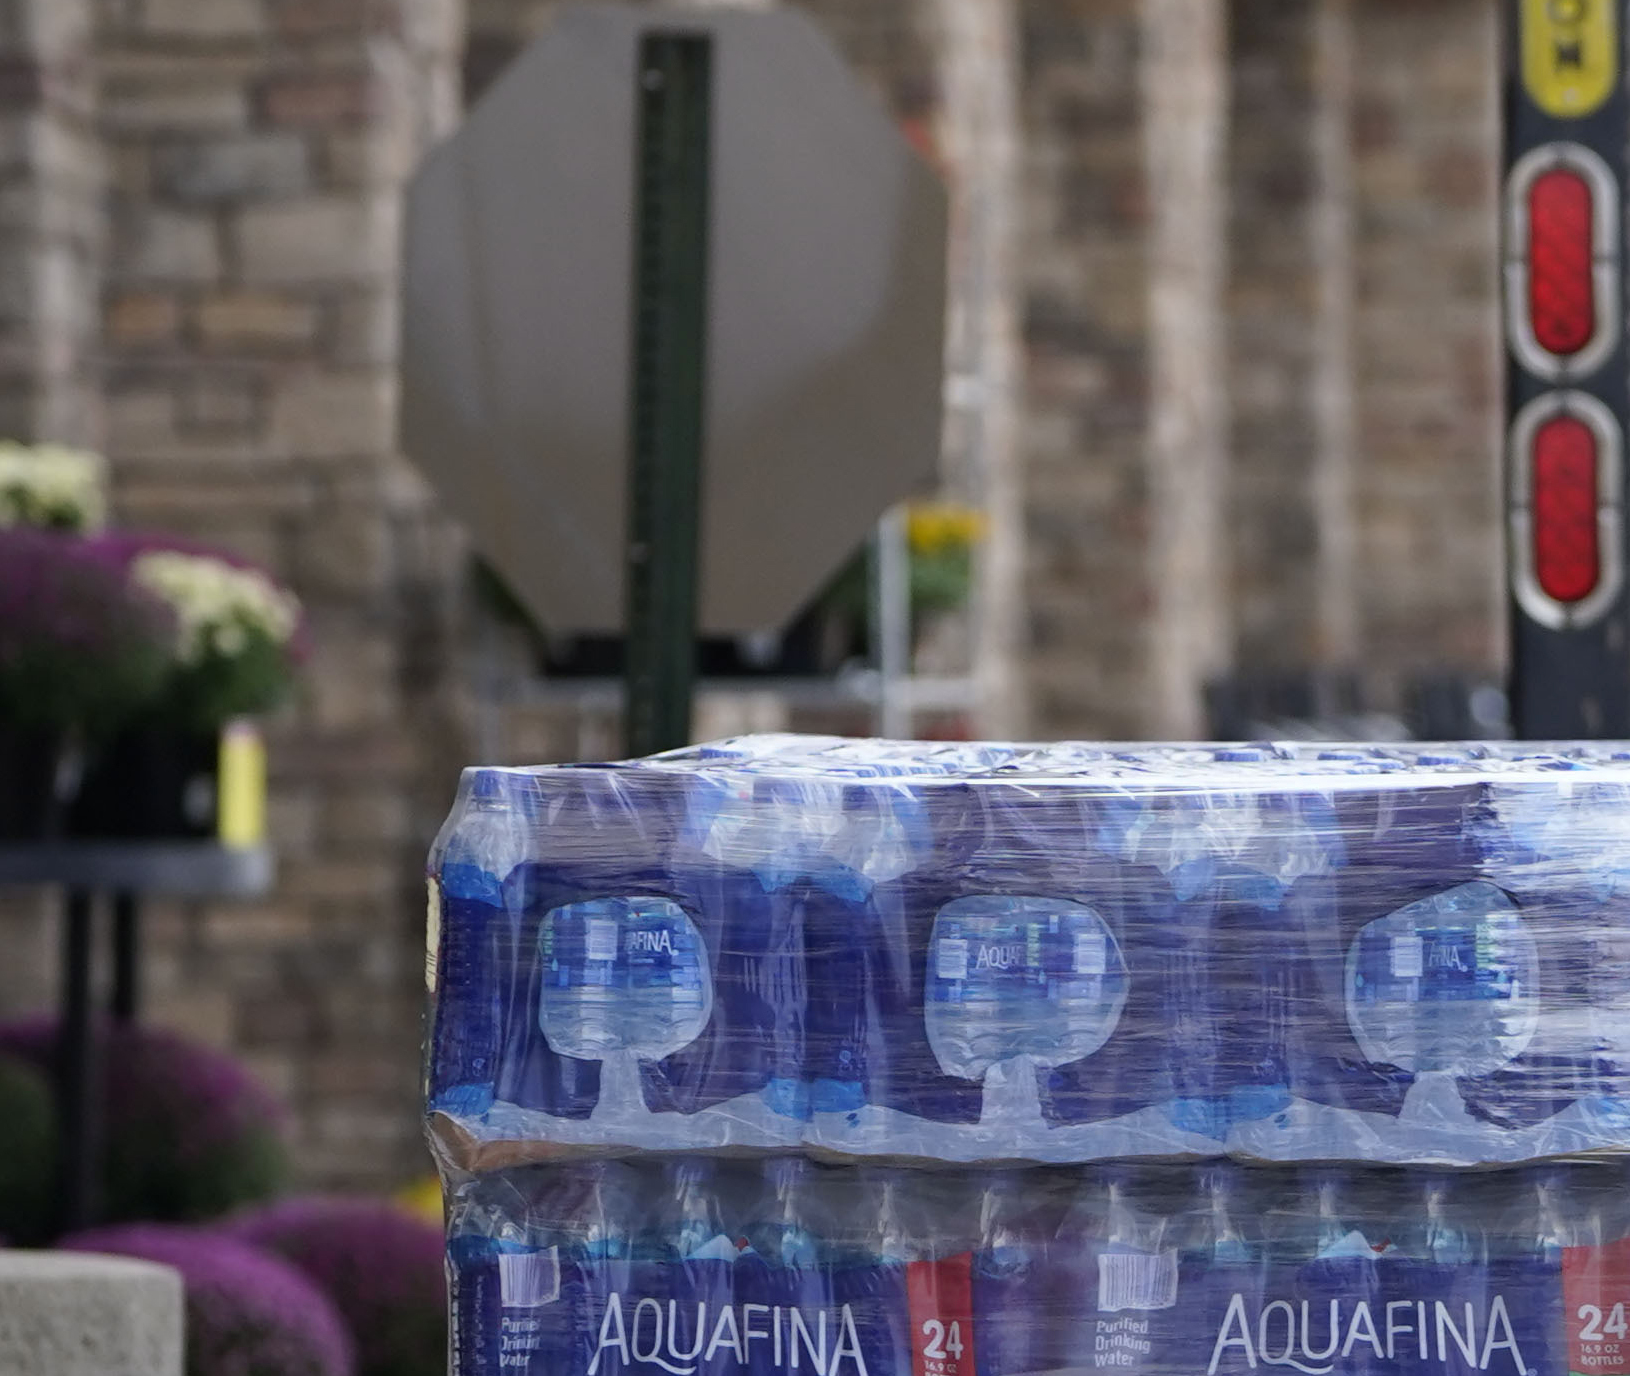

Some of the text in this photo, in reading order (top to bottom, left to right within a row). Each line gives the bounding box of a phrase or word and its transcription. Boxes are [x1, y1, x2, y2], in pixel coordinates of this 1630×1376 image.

[1096, 1317, 1149, 1334] Purified
[1577, 1301, 1628, 1341] 24
[922, 1318, 964, 1361] 24
[1207, 1292, 1528, 1376] AQUAFINA
[1095, 1333, 1151, 1355] Drinking
[1604, 1343, 1620, 1354] OZ
[1094, 1352, 1135, 1368] Water
[1580, 1354, 1625, 1367] BOTTLES
